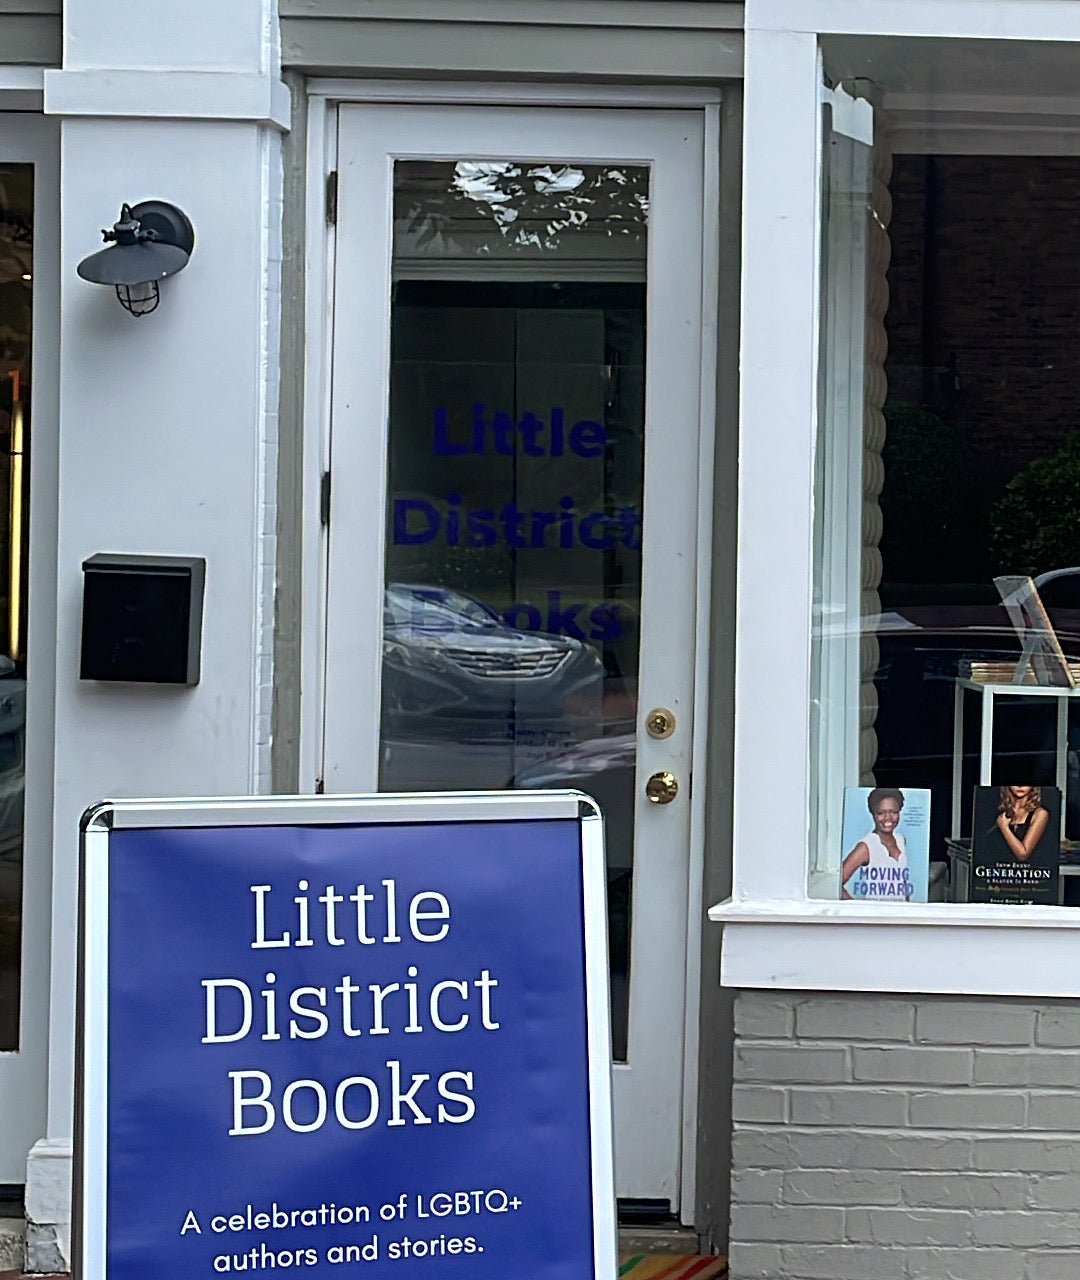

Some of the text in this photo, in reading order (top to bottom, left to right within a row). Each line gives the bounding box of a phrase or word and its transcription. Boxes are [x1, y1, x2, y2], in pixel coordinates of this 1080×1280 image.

[431, 401, 609, 459] Little
[393, 491, 642, 552] District
[853, 882, 914, 896] FORWARD
[860, 867, 910, 880] MOVING
[975, 865, 1051, 878] GENERATION
[251, 880, 449, 948] Little
[202, 967, 500, 1043] District
[229, 1061, 476, 1135] Books
[181, 1189, 522, 1235] A celebration of LGBTQ+
[213, 1234, 484, 1272] authors and stories.
